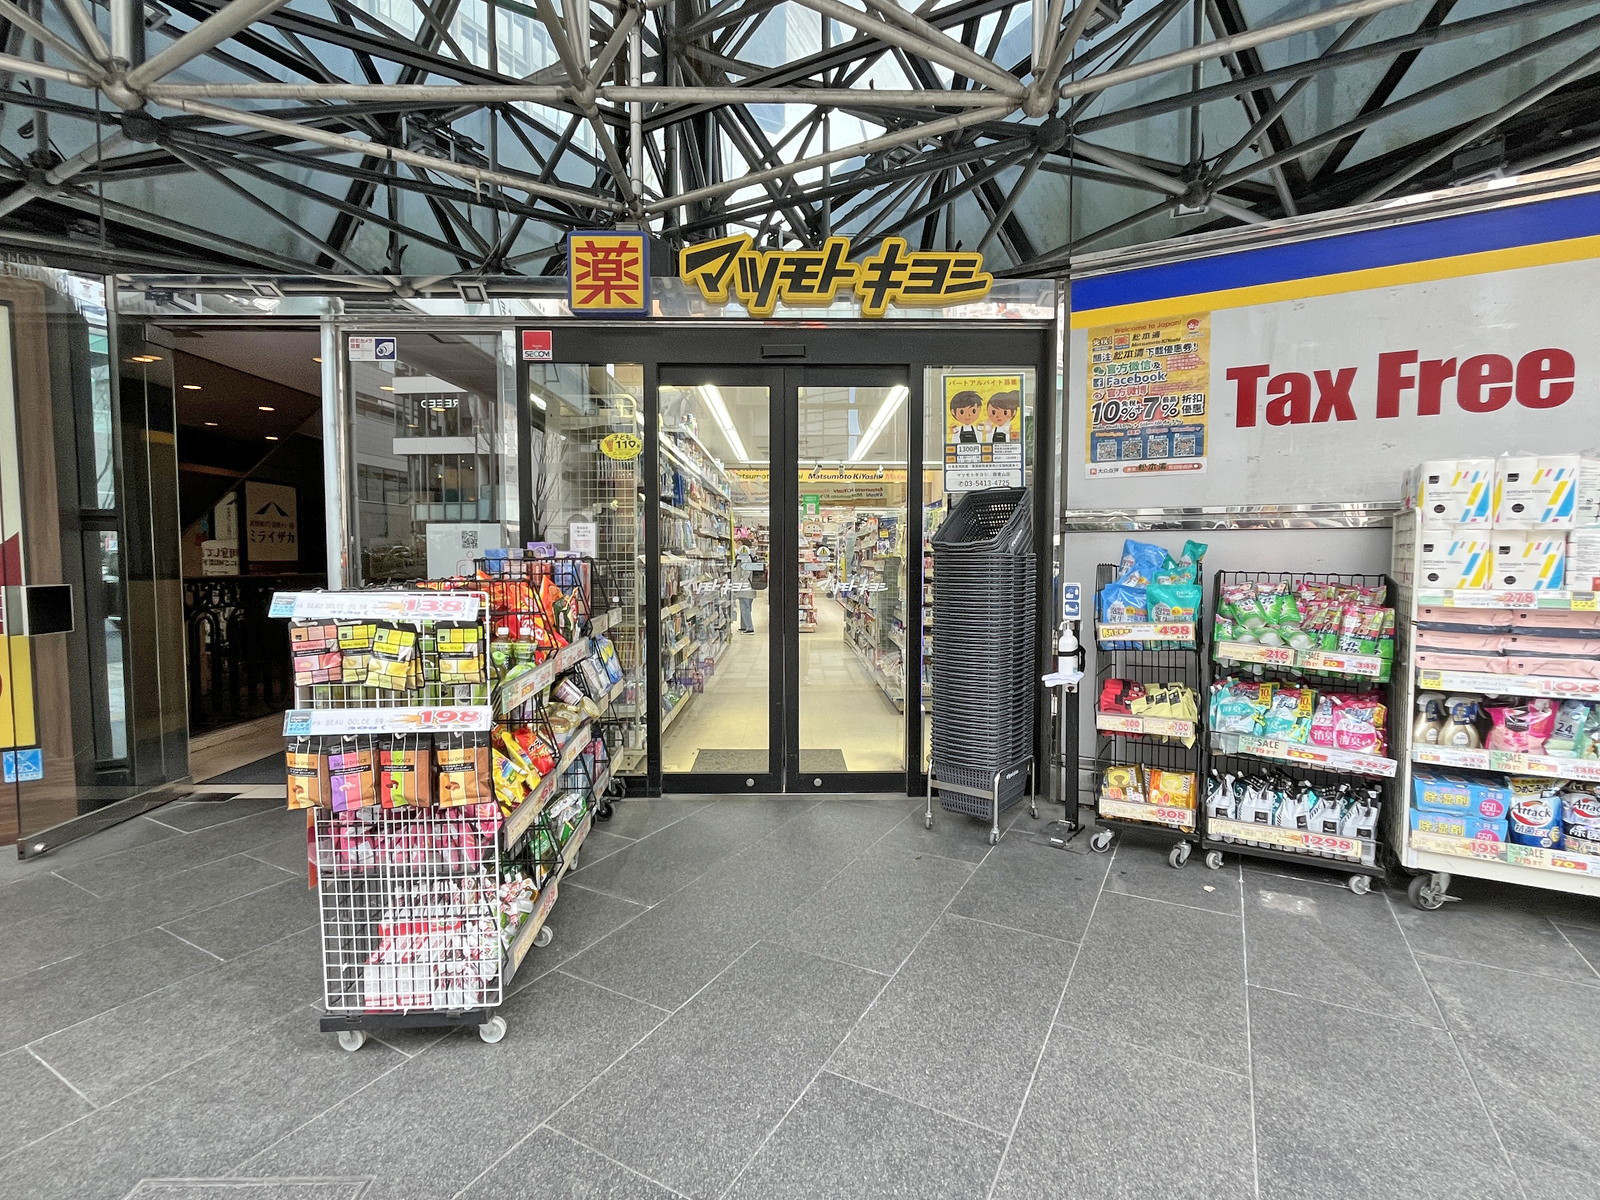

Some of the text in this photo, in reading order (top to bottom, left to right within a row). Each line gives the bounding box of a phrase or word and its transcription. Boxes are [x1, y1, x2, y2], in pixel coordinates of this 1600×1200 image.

[574, 241, 641, 306] 薬
[684, 238, 990, 309] マツモトキヨシ
[1115, 325, 1146, 334] Welcome
[1157, 319, 1182, 329] Japan!
[524, 350, 551, 358] SECOM
[1107, 359, 1152, 374] 官方微信
[1106, 372, 1167, 387] Facebook
[1226, 348, 1577, 429] Tax Free
[250, 530, 296, 544] ミライザカ
[680, 578, 752, 595] マツモトキヨシ
[817, 576, 889, 595] マツモトキヨシ
[1503, 592, 1535, 603] 278
[405, 599, 464, 612] 138
[1159, 626, 1190, 635] 498
[1266, 650, 1288, 660] 216
[420, 710, 480, 723] 198
[1173, 722, 1189, 731] 700
[1257, 739, 1280, 749] SALE
[1424, 791, 1470, 807] 除湿剤
[1573, 799, 1600, 813] Attac
[1157, 808, 1186, 819] 908
[1481, 802, 1497, 812] 550
[1512, 801, 1552, 818] Attack
[1419, 820, 1465, 836] 除湿剤
[1301, 834, 1351, 850] 1298
[1470, 842, 1500, 854] 198
[1525, 849, 1544, 859] SALE
[1555, 860, 1576, 868] 70
